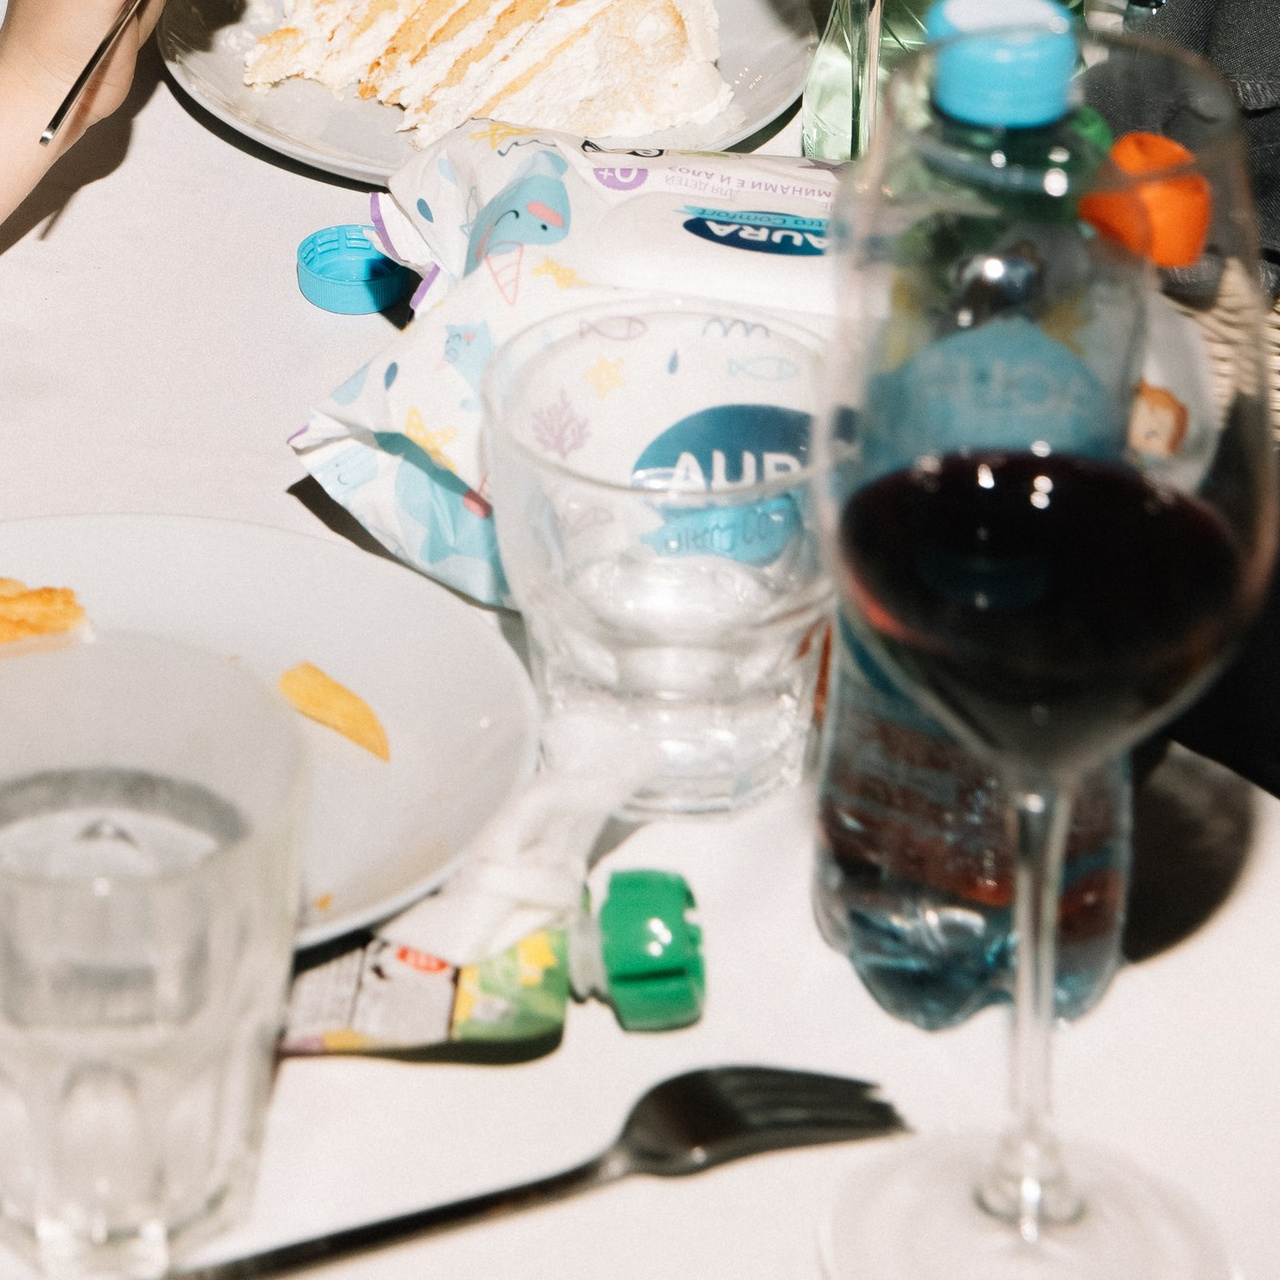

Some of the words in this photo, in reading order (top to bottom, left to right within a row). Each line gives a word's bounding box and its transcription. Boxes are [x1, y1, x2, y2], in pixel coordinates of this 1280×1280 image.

[664, 174, 708, 191] ДЕТЕЙ
[711, 182, 741, 200] ДЛЯ
[751, 180, 832, 200] МИНАМИ
[698, 208, 784, 228] Comfort
[793, 217, 828, 230] tra
[705, 219, 827, 250] AURA
[671, 448, 806, 493] AUR
